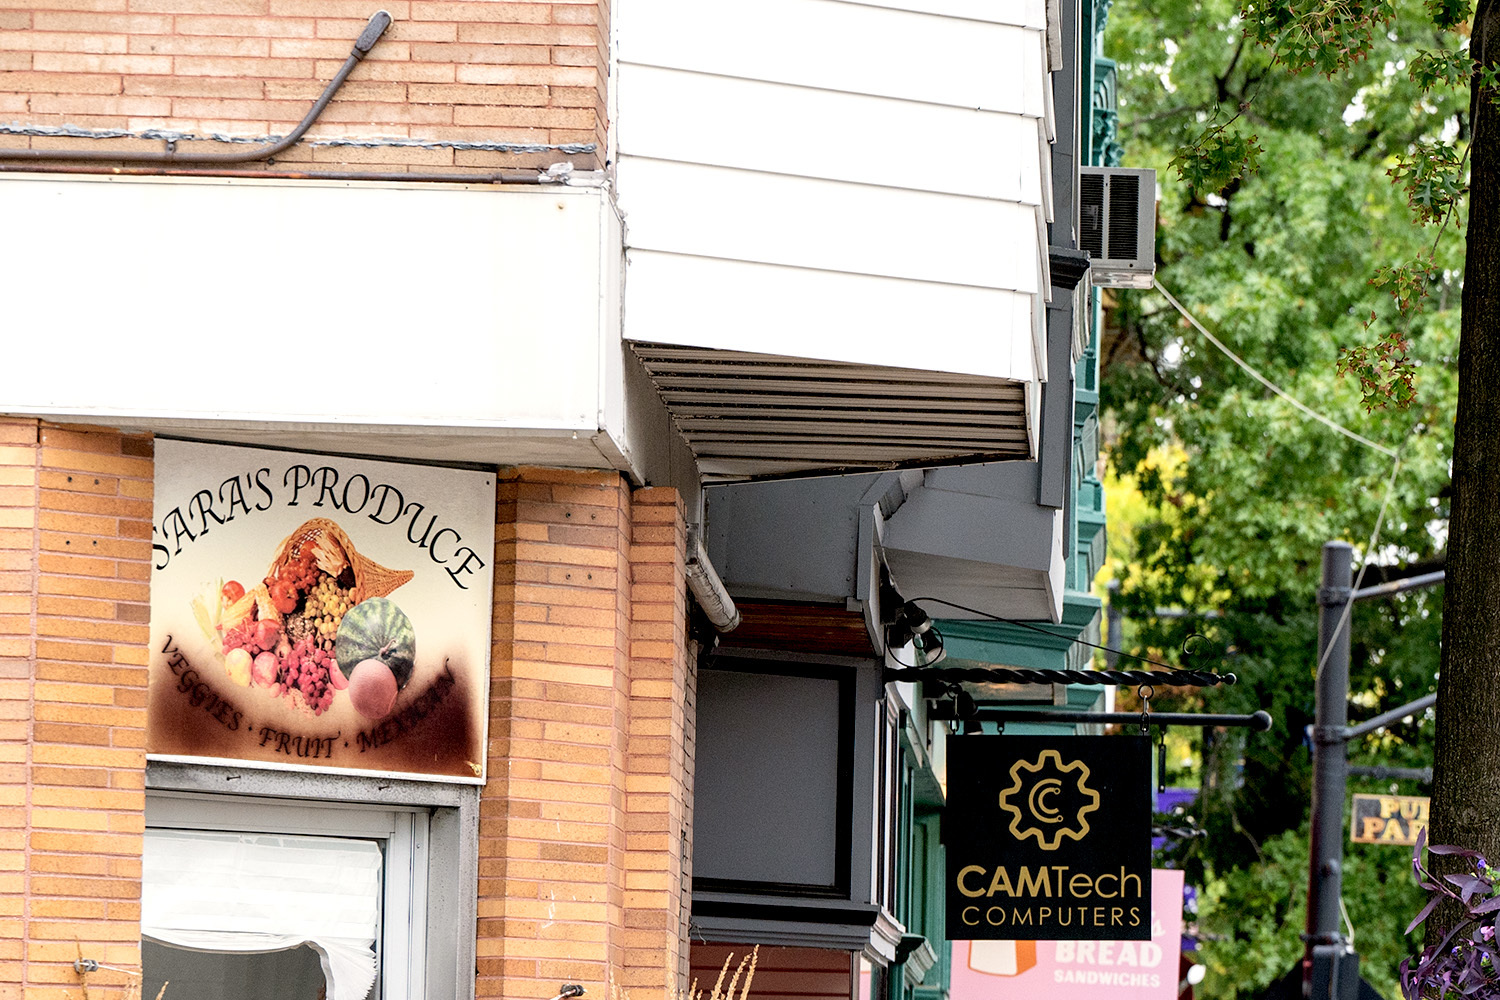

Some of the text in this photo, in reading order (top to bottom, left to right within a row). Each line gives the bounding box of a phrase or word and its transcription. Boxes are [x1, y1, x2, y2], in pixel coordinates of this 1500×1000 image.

[153, 464, 485, 590] SARA'S PRODUCE
[161, 635, 243, 731] VEGGIES
[259, 726, 341, 759] FRUIT
[957, 864, 1142, 899] CAMTech
[961, 905, 1141, 927] COMPUTERS
[1055, 940, 1163, 968] BREAD
[1054, 969, 1161, 988] SANDWICHES
